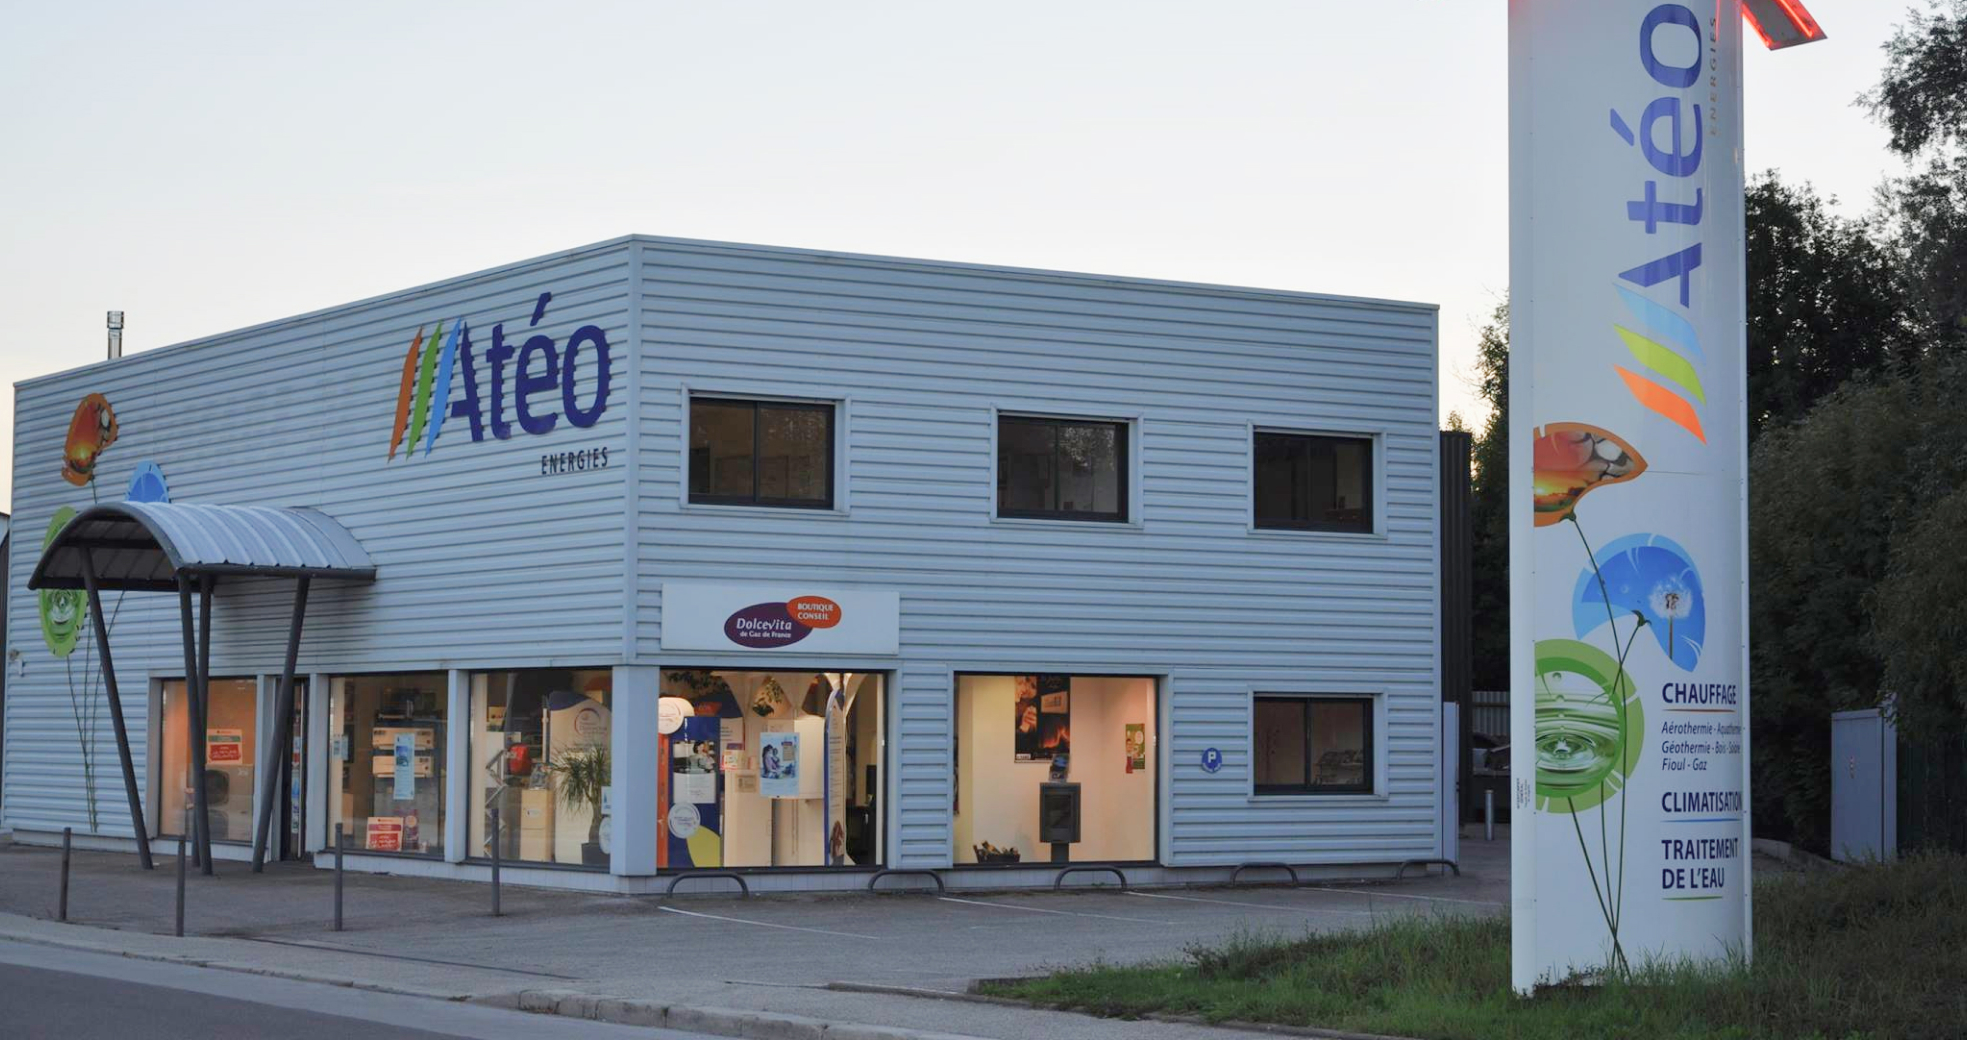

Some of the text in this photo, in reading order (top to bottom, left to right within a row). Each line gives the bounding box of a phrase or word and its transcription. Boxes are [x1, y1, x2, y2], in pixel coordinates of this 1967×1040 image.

[1709, 17, 1718, 137] ENERGIES
[1610, 3, 1703, 309] Atéo
[451, 292, 612, 442] Atéo
[541, 446, 608, 475] ENERGIES
[797, 602, 834, 612] BOUTIQUE
[797, 611, 829, 620] CONSEIL
[749, 630, 761, 638] Gaz
[1661, 682, 1737, 704] CHAUFFAGE
[1661, 721, 1713, 735] Aérothermie
[1661, 740, 1711, 754] Géothermie
[1661, 757, 1686, 771] Fioul
[1692, 757, 1707, 771] Gaz
[1661, 838, 1738, 860] TRAITEMENT
[1662, 867, 1725, 889] DE L'EAU
